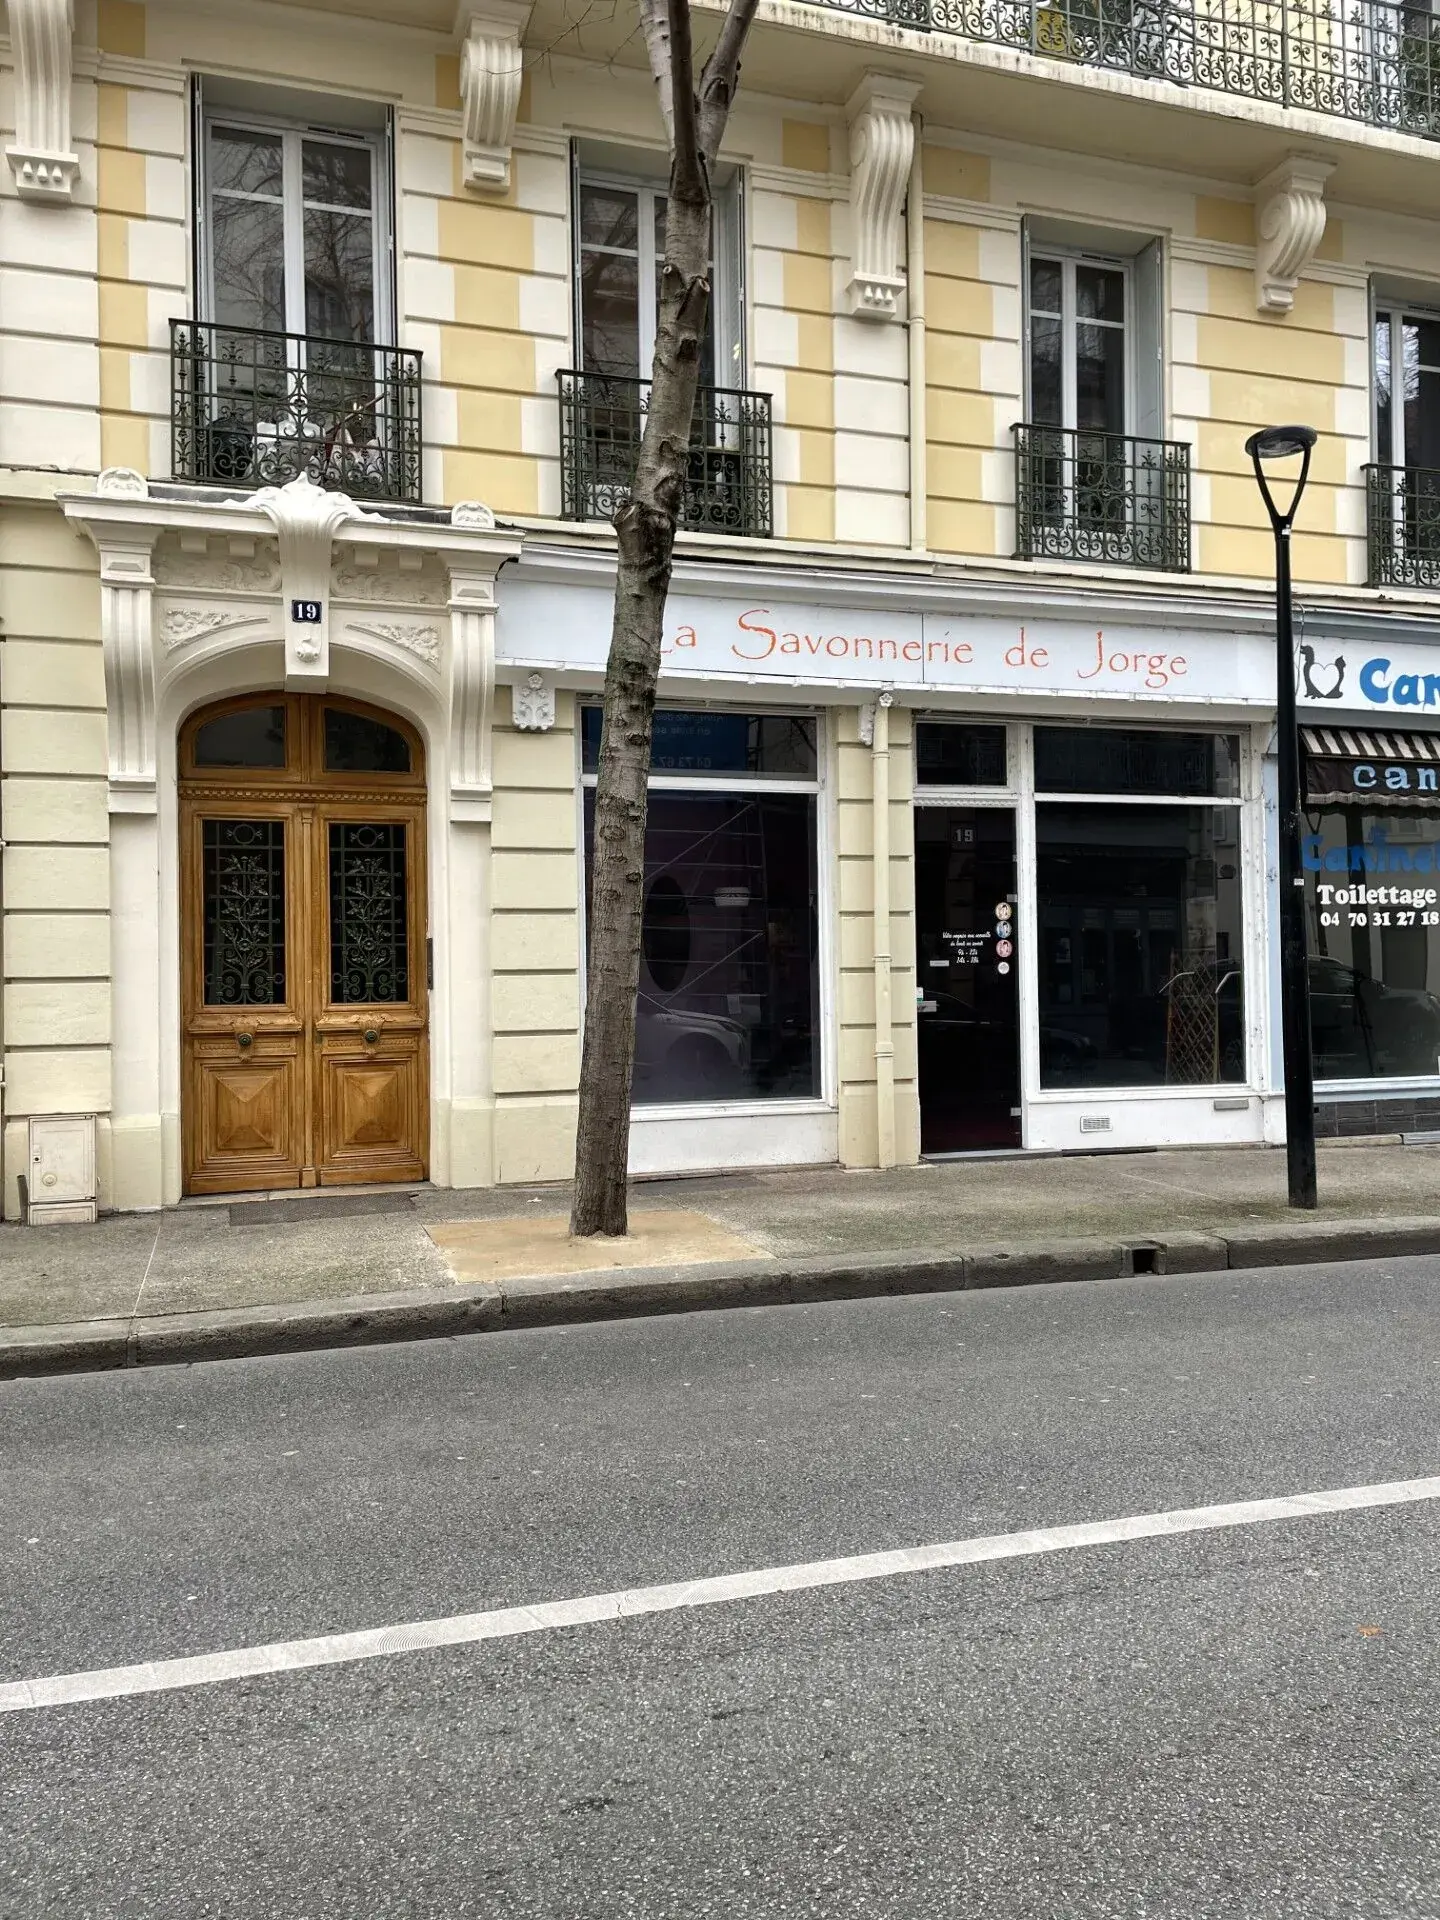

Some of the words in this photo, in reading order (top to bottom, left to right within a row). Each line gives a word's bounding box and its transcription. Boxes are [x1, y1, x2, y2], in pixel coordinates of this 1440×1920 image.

[296, 603, 317, 620] 19
[660, 625, 697, 654] a
[731, 608, 974, 664] Savonnerie
[1005, 626, 1050, 668] de
[1076, 630, 1187, 689] Jorge
[1353, 765, 1439, 791] can
[1316, 884, 1438, 908] Toilettage
[1320, 911, 1340, 927] 04
[1348, 912, 1368, 927] 70
[1372, 911, 1392, 926] 31
[1396, 911, 1416, 926] 27
[1420, 911, 1440, 925] 18
